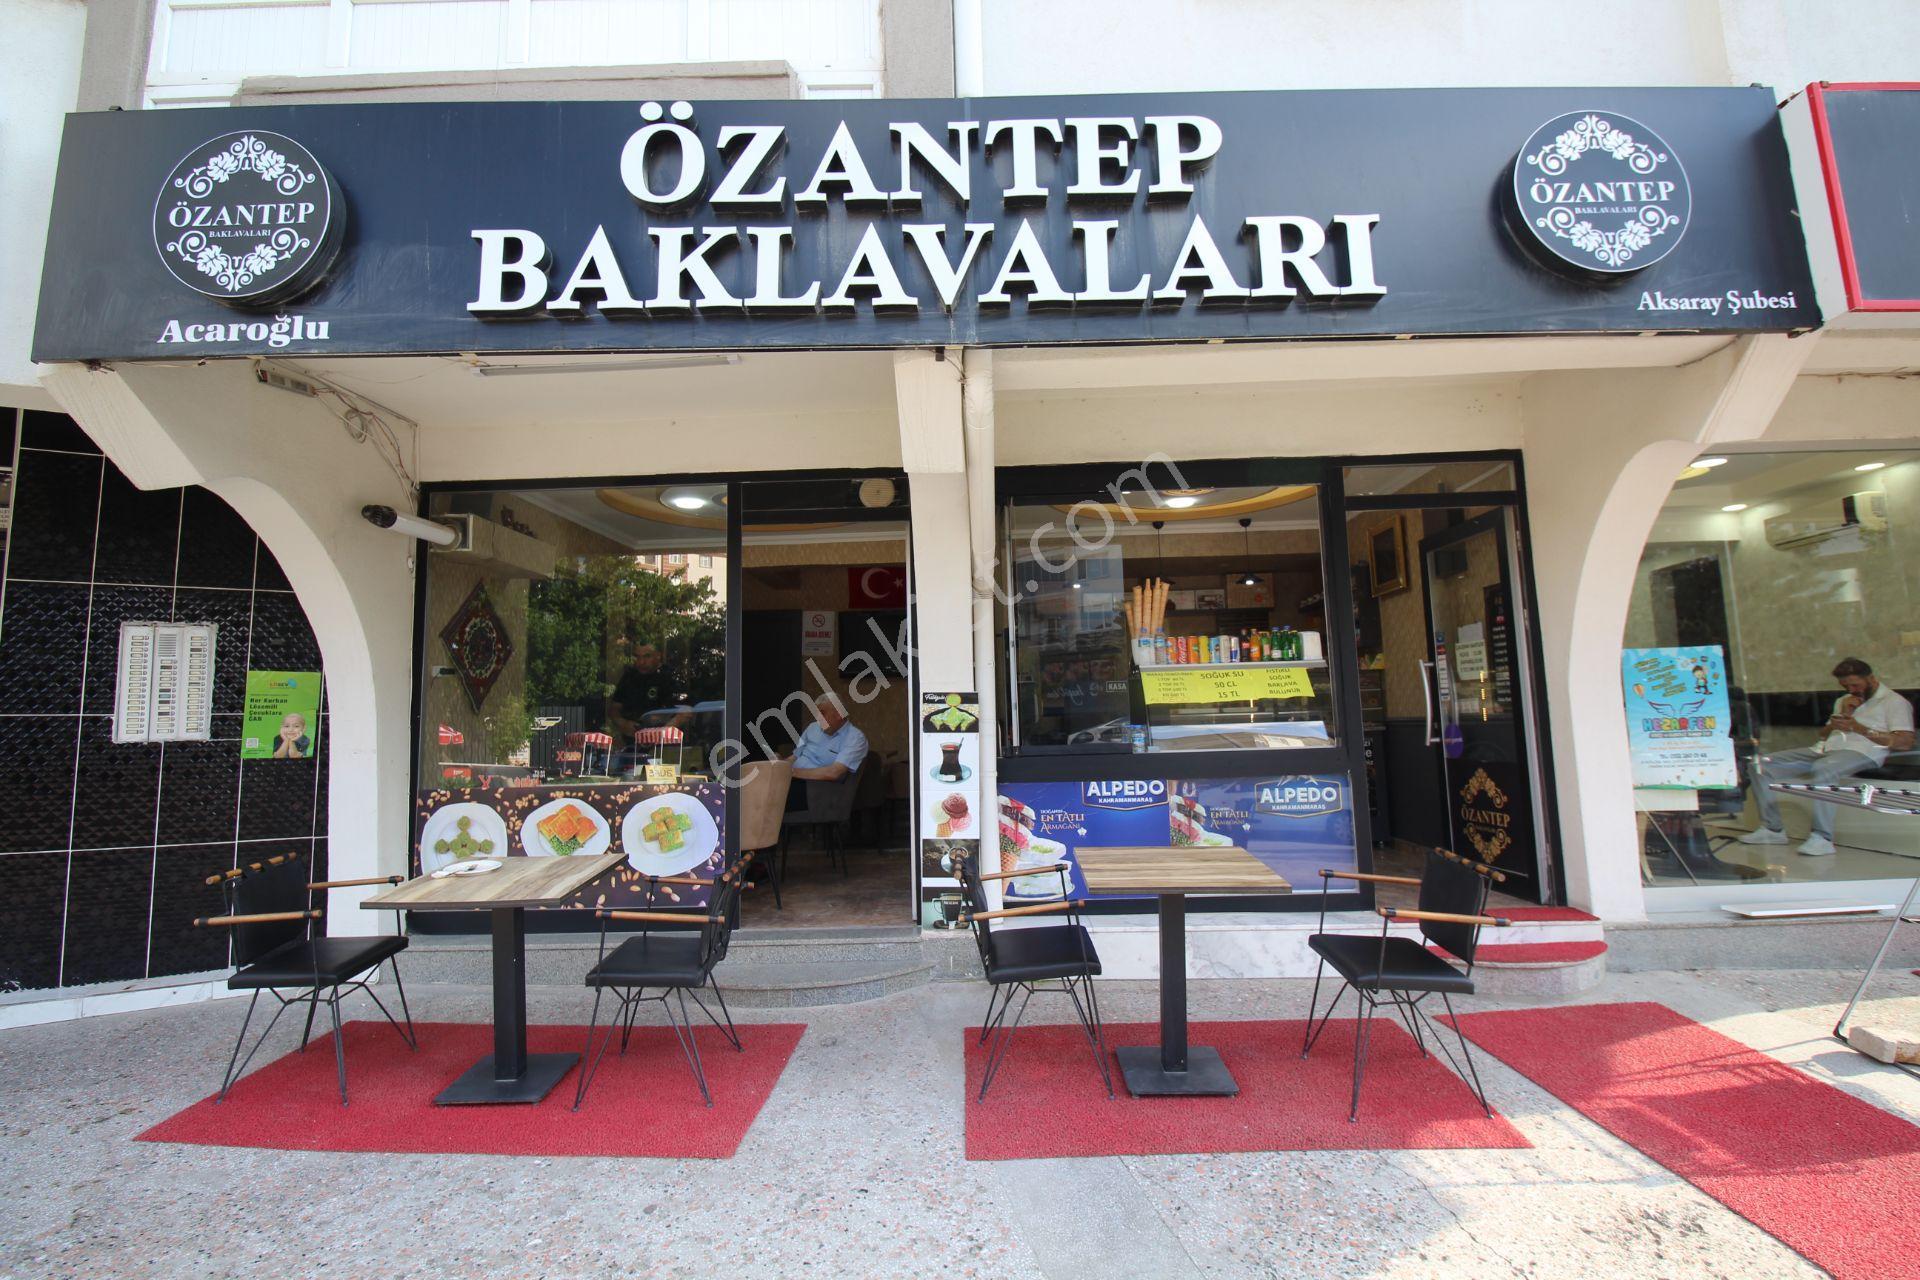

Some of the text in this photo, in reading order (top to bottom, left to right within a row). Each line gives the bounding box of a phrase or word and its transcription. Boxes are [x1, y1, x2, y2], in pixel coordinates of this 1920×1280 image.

[620, 101, 1223, 205] ÖZANTEP
[1530, 178, 1675, 203] ÖZANTEP
[168, 201, 315, 229] ÖZANTEP
[1574, 205, 1637, 216] BAKLAVALARI
[208, 228, 272, 239] BAKLAVALARI
[466, 212, 1388, 314] BAKLAVALARI
[1637, 289, 1797, 315] Aksaray Şubesi
[157, 314, 330, 347] Acaroğlu
[1200, 670, 1244, 680] SOĞUK SU
[1087, 780, 1164, 797] ALPEDO
[1260, 787, 1337, 803] ALPEDO
[1040, 812, 1084, 823] EN TATLI
[1461, 804, 1510, 828] ÖZANTEP
